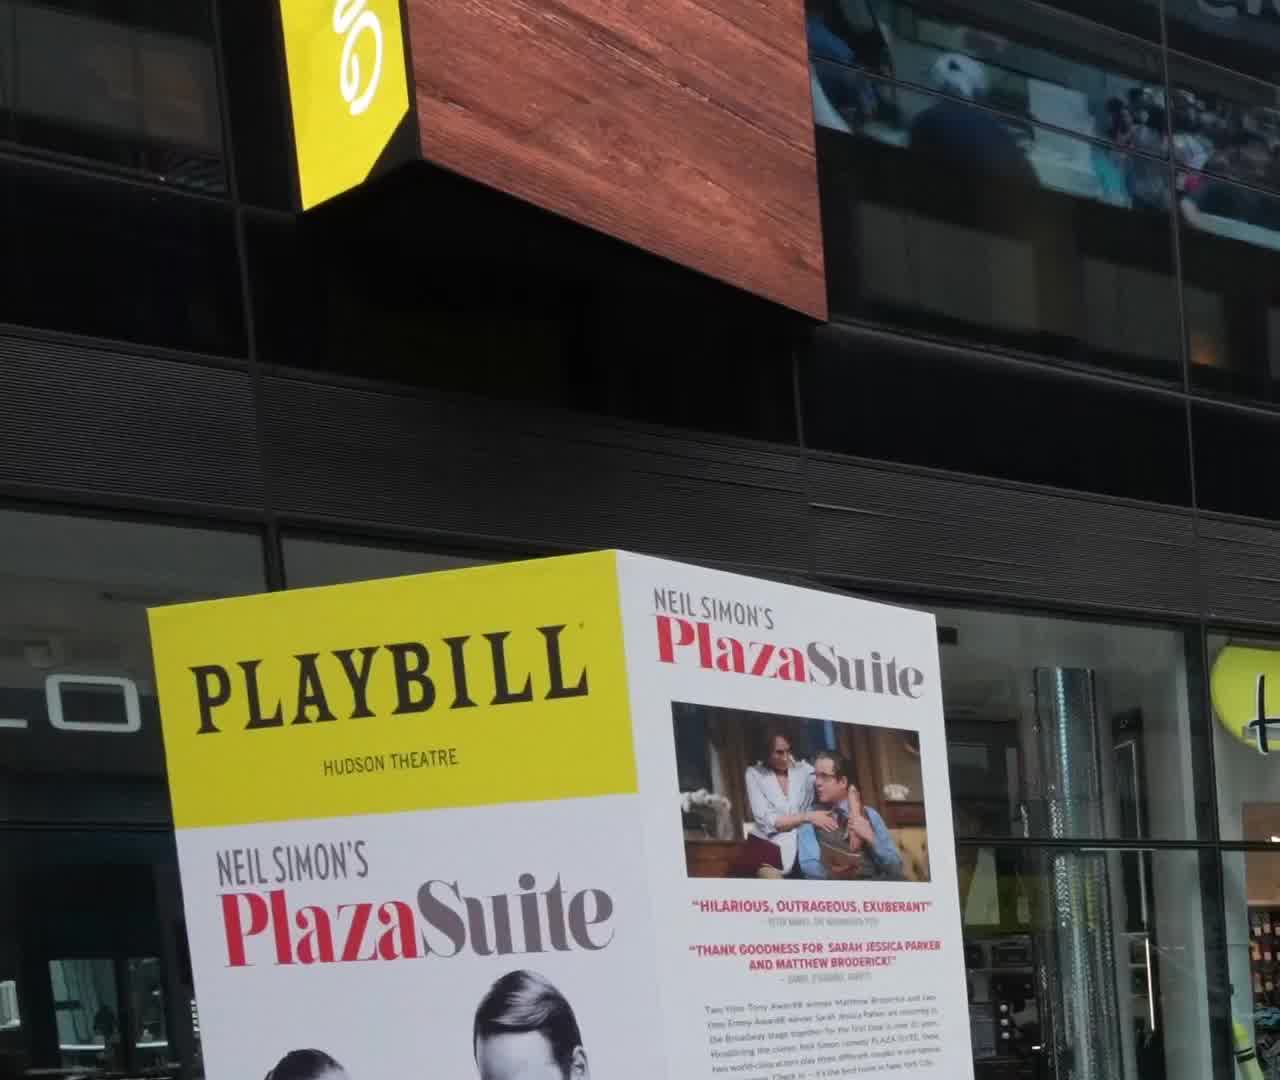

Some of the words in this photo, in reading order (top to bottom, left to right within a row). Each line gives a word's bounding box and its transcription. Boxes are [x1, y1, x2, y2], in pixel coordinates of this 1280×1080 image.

[653, 587, 695, 616] NEIL
[700, 596, 774, 629] SIMON'S
[189, 624, 588, 734] PLAYBILL
[322, 754, 384, 776] HUDSON
[389, 748, 457, 770] THEATRE
[215, 849, 267, 886] NEIL
[271, 839, 369, 882] SIMON'S
[749, 959, 773, 970] AND
[776, 957, 827, 969] MATTHEW
